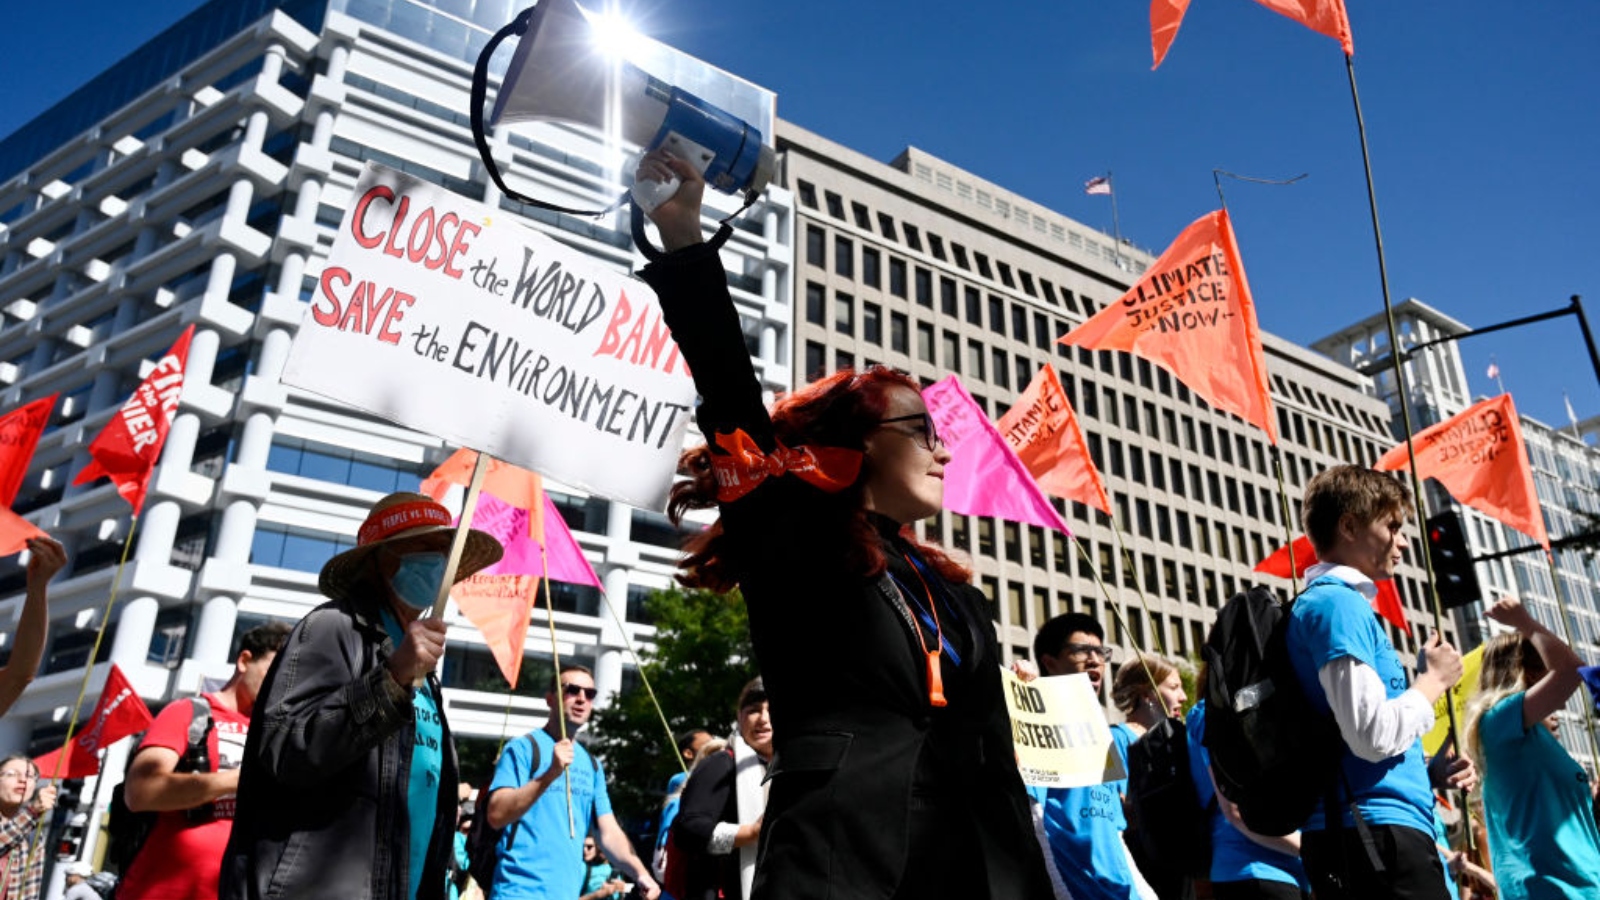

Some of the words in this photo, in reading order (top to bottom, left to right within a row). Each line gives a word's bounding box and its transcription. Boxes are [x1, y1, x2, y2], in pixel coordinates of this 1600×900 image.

[351, 185, 482, 279] CLOSE
[469, 258, 509, 297] the
[510, 246, 606, 335] WORLD
[311, 266, 416, 346] SAVE
[411, 319, 450, 362] the
[1125, 281, 1227, 328] JUSTICE
[1157, 307, 1220, 333] NOW
[1010, 680, 1046, 714] END
